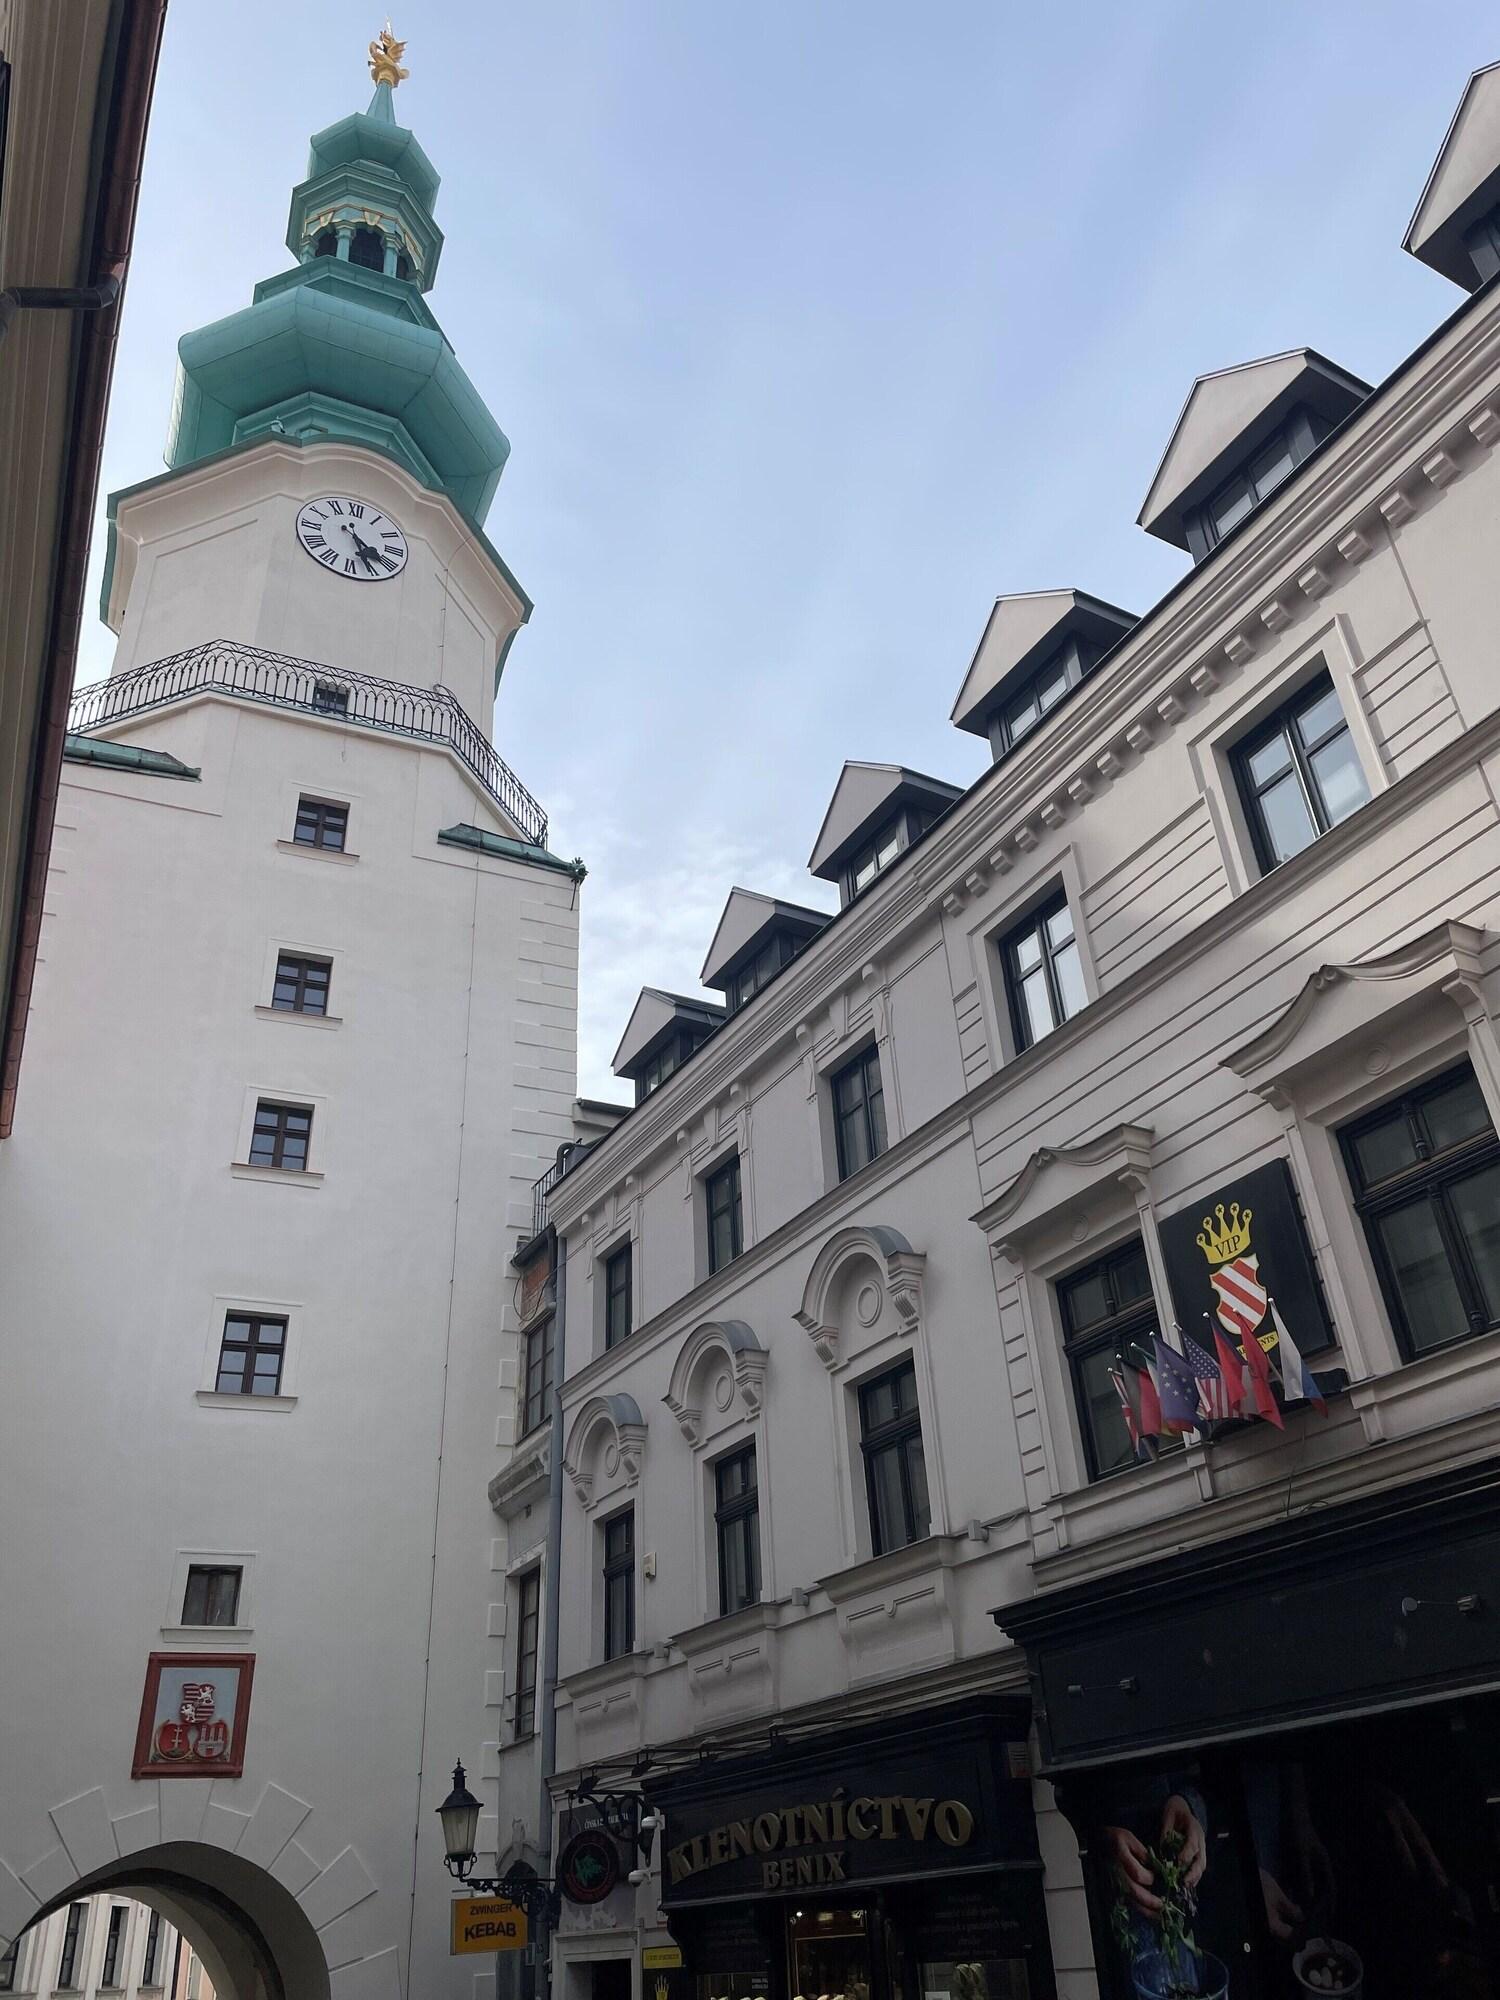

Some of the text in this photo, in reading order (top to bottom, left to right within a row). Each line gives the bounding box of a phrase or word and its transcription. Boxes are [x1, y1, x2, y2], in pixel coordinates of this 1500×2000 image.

[309, 506, 329, 520] X
[327, 500, 344, 515] XI
[348, 502, 364, 519] XII
[301, 518, 322, 531] IX
[370, 515, 383, 525] I
[303, 535, 327, 549] VIII
[319, 548, 339, 565] VII
[385, 544, 403, 557] III
[344, 558, 357, 574] VI
[1215, 1234, 1241, 1258] VIP
[667, 1787, 976, 1885] KLENOTNÍCTVO
[762, 1851, 847, 1889] BENIX
[470, 1904, 512, 1916] ZWINGER
[464, 1920, 517, 1942] KEBAB
